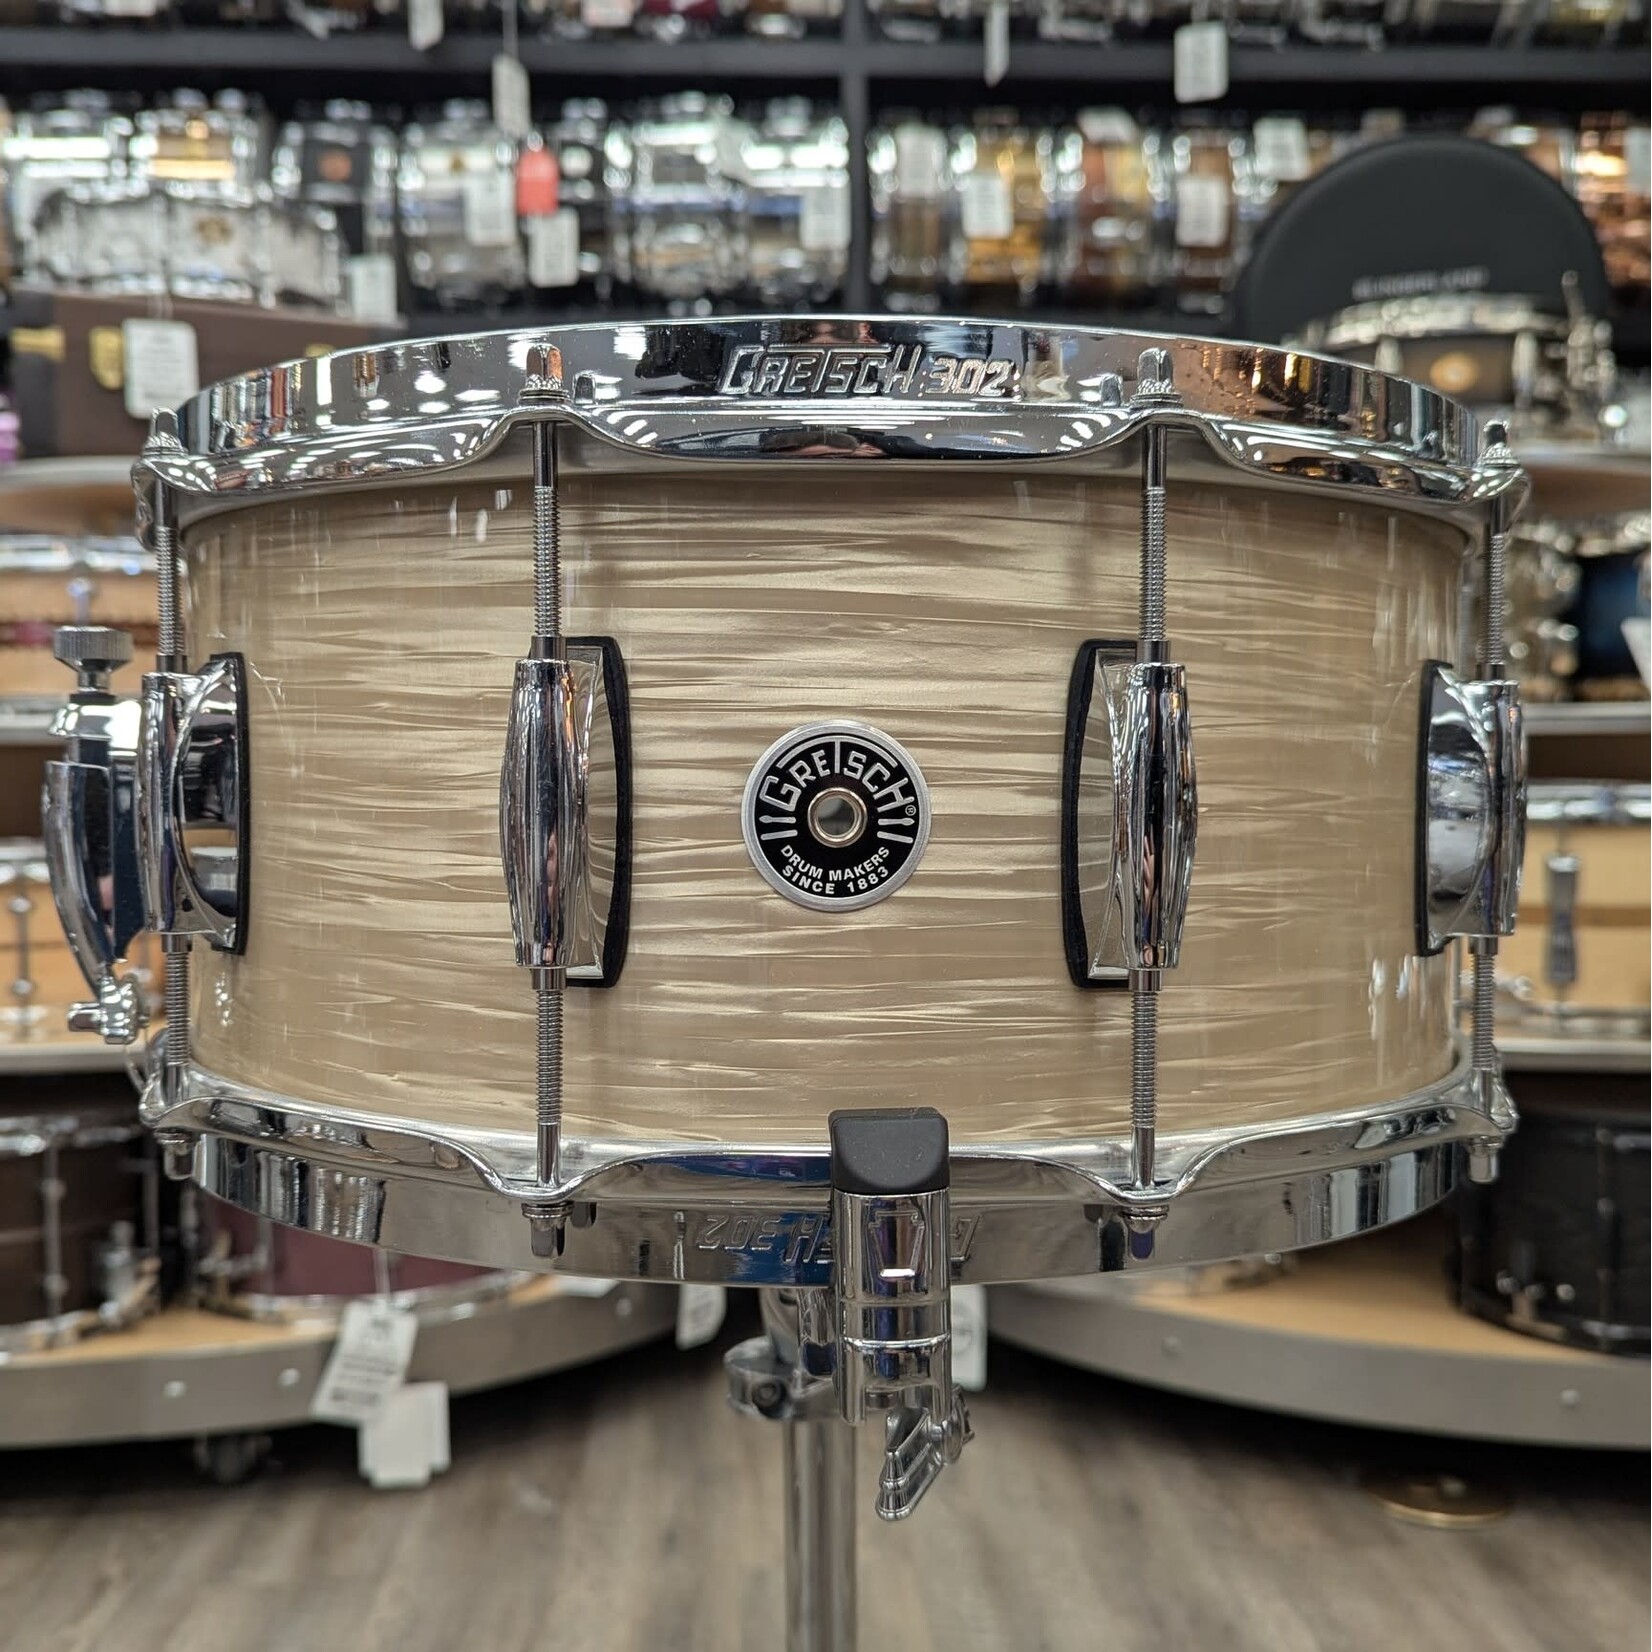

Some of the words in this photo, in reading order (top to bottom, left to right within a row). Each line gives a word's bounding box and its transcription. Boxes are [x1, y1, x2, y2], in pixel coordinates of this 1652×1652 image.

[720, 343, 924, 395] GRETSCH
[925, 357, 1015, 397] 302
[759, 735, 915, 812] GRETSCH
[781, 845, 823, 880] DRUM
[829, 846, 890, 881] MAKERS
[782, 865, 835, 894] SINCE
[847, 866, 889, 893] 1883
